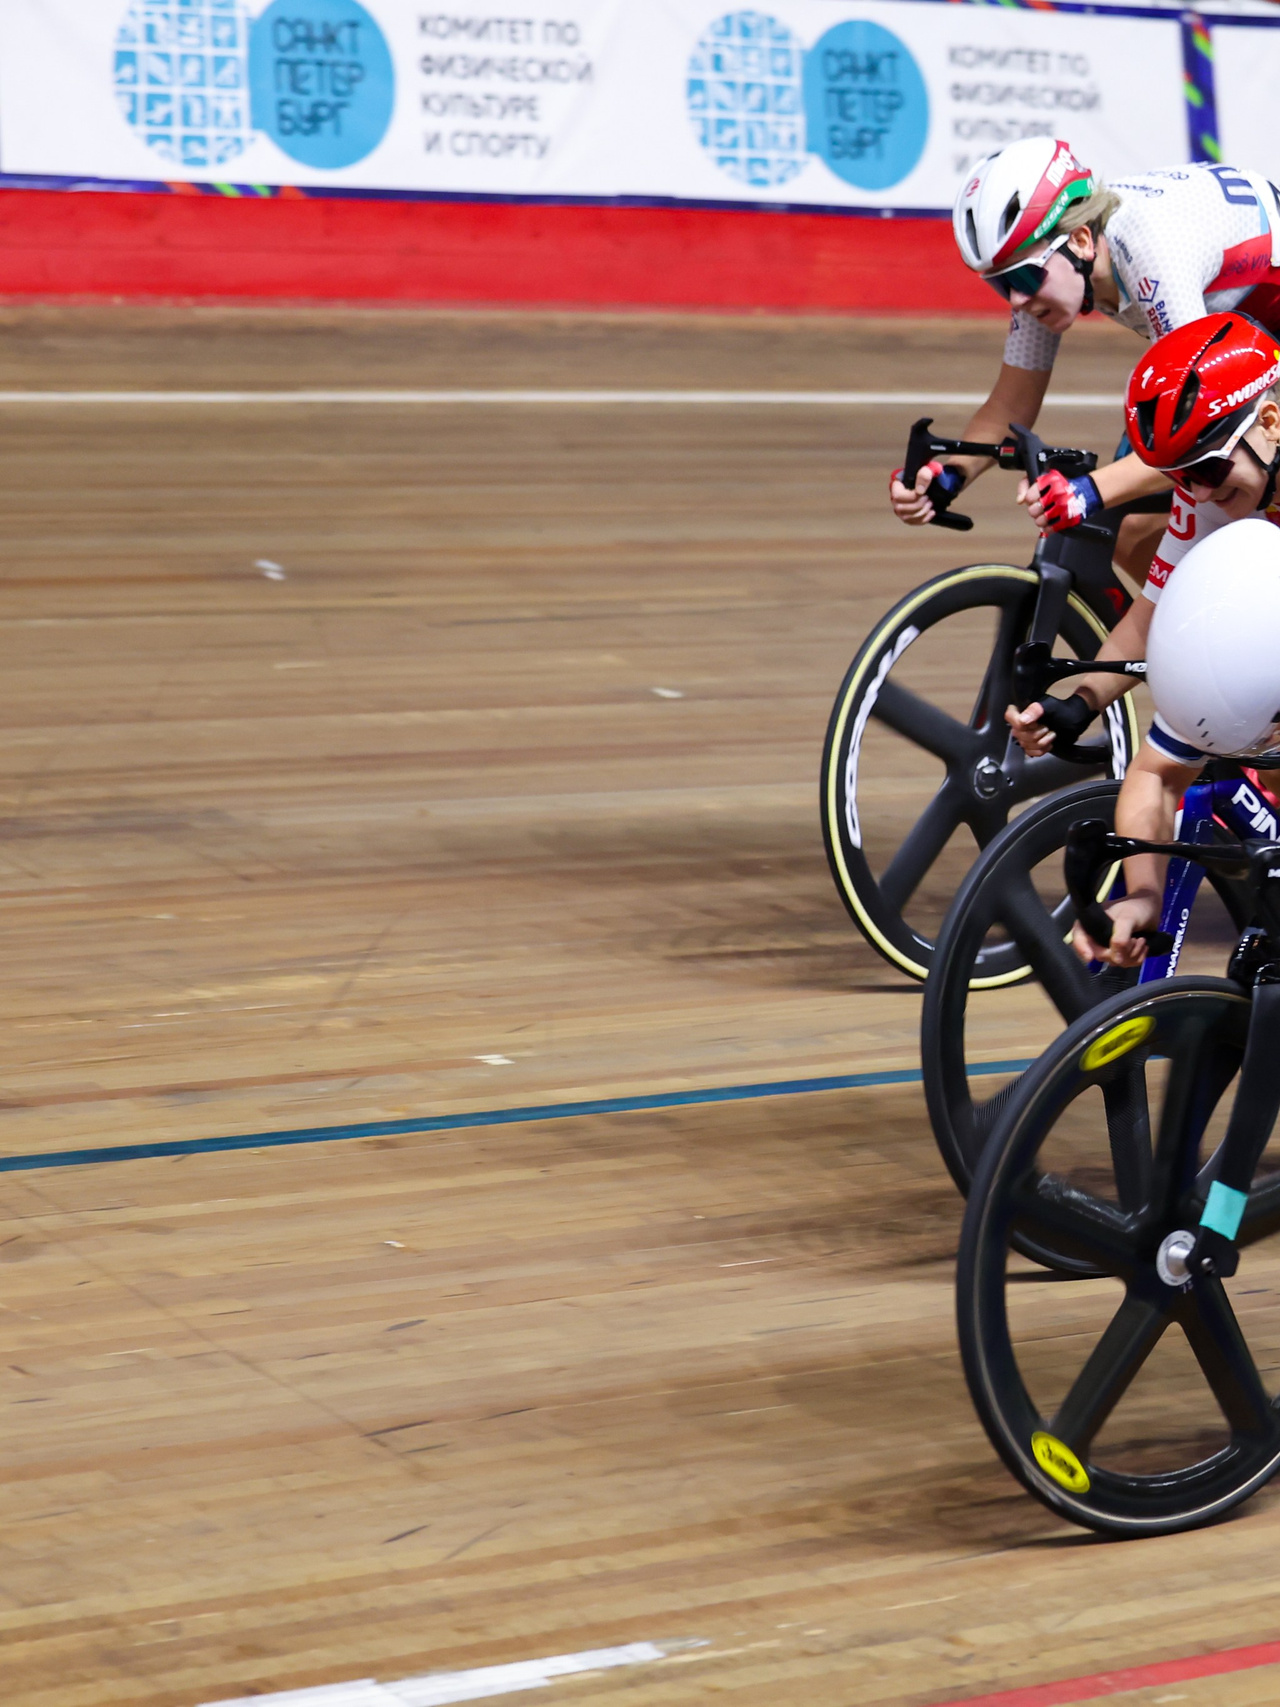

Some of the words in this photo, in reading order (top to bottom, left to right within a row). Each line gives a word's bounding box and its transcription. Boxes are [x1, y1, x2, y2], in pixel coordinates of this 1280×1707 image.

[272, 17, 360, 52] САНКТ
[418, 15, 534, 44] КОМИТЕТ
[543, 21, 580, 46] ПО
[274, 60, 365, 97] ПЕТЕР
[419, 52, 594, 84] ФИЗИЧЕСКОЙ
[276, 99, 352, 137] БУРГ
[422, 92, 540, 121] КУЛЬТУРЕ
[424, 131, 441, 154] И
[450, 131, 549, 160] СПОРТУ
